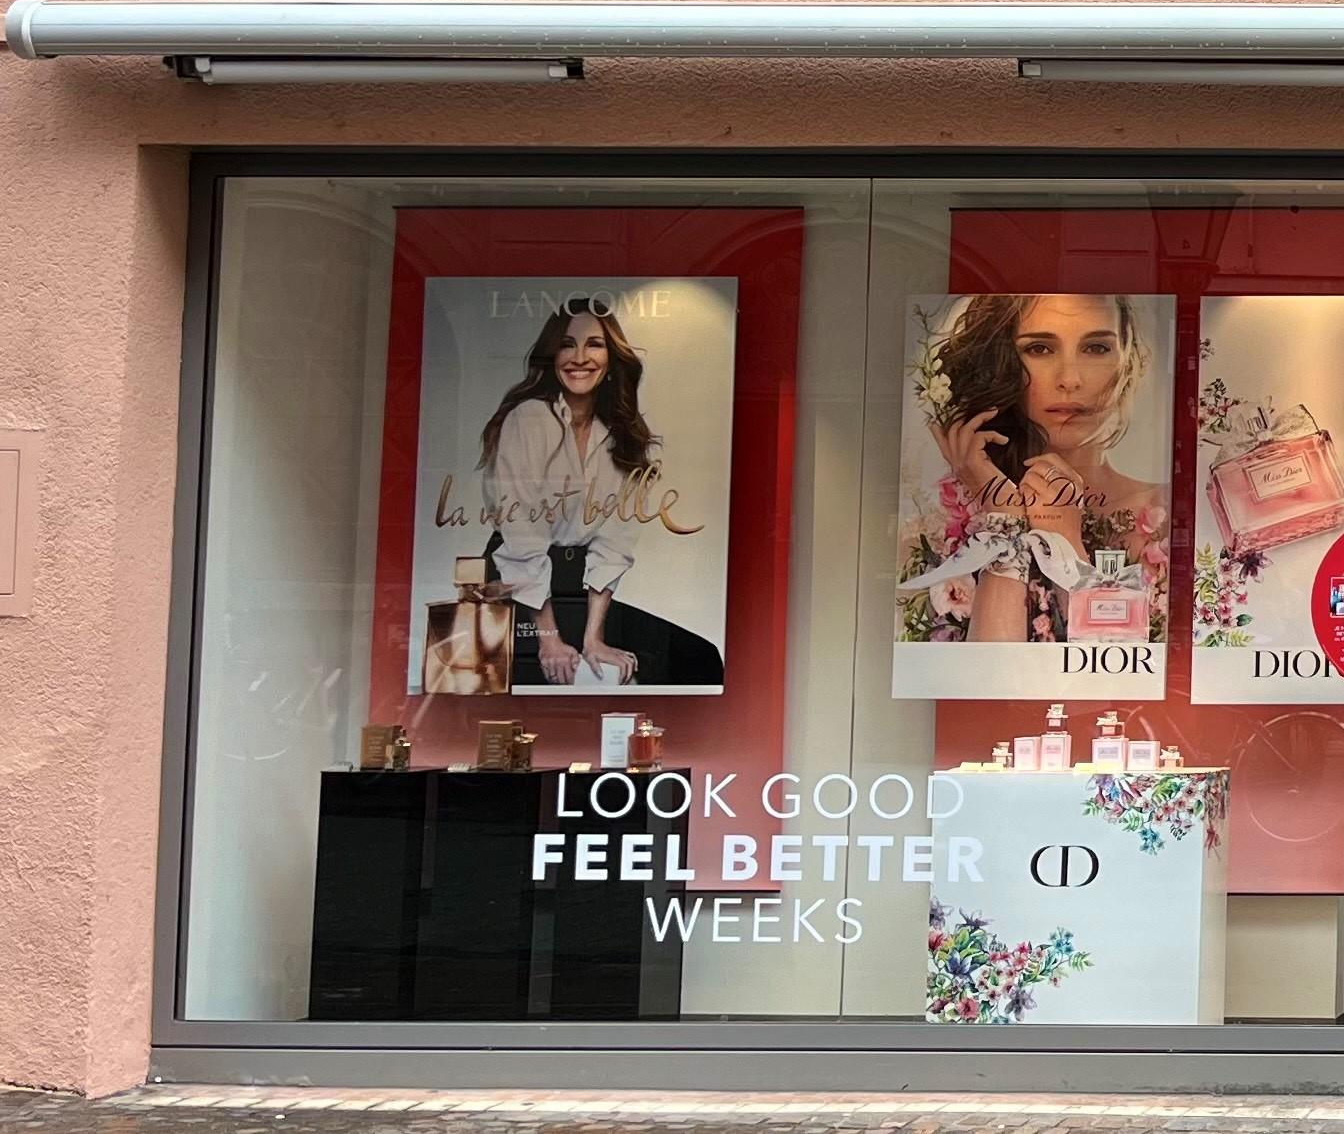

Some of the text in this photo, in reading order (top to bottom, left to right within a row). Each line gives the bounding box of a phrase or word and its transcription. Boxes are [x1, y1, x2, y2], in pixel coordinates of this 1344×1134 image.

[491, 286, 671, 317] LANCÔME
[435, 474, 468, 527] la
[529, 474, 581, 523] est
[582, 460, 704, 535] belle
[959, 475, 1110, 507] Miss Dior
[1060, 646, 1155, 674] DIOR
[556, 772, 965, 820] LOOK GOOD
[531, 833, 985, 883] FEEL BETTER
[645, 896, 864, 944] WEEKS
